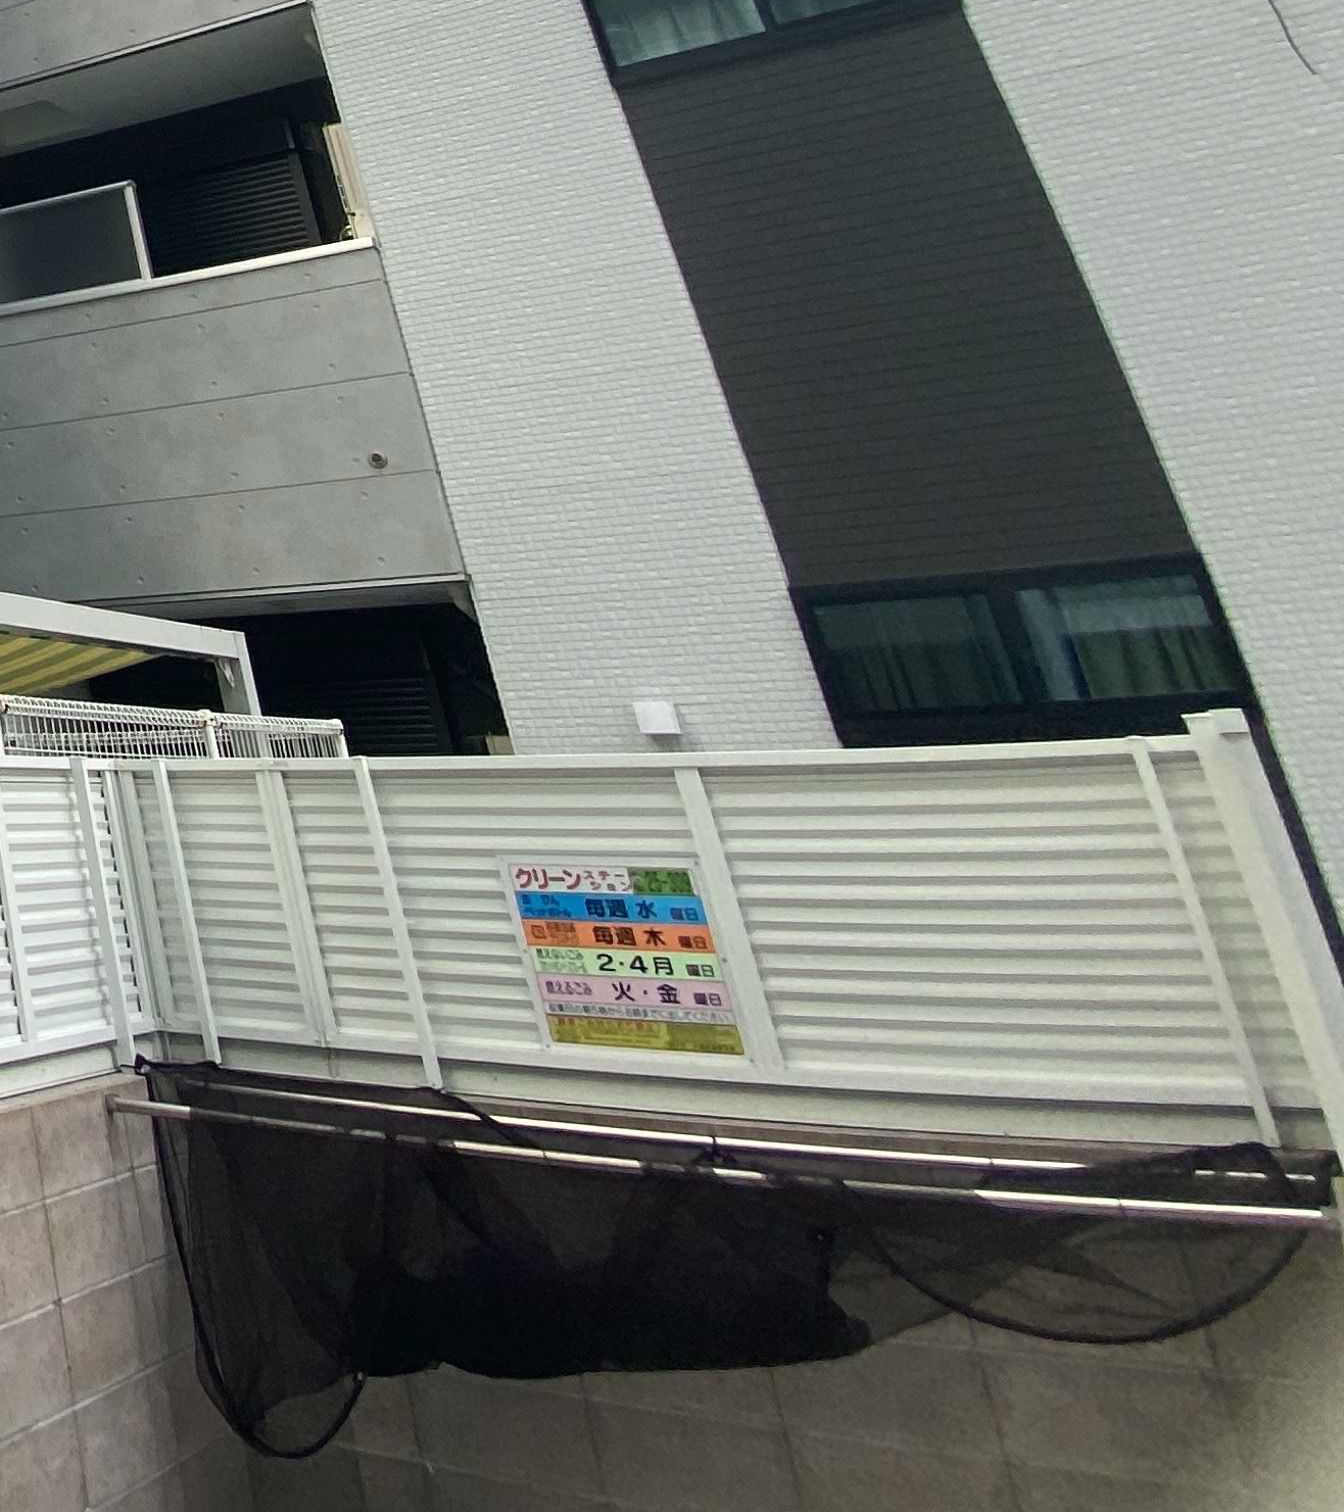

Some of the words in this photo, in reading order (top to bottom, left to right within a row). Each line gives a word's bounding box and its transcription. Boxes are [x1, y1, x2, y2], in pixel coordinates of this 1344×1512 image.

[515, 868, 581, 890] クリーン
[585, 898, 629, 919] 毎週
[635, 899, 657, 919] 水
[593, 926, 637, 946] 毎週
[643, 928, 666, 946] 木
